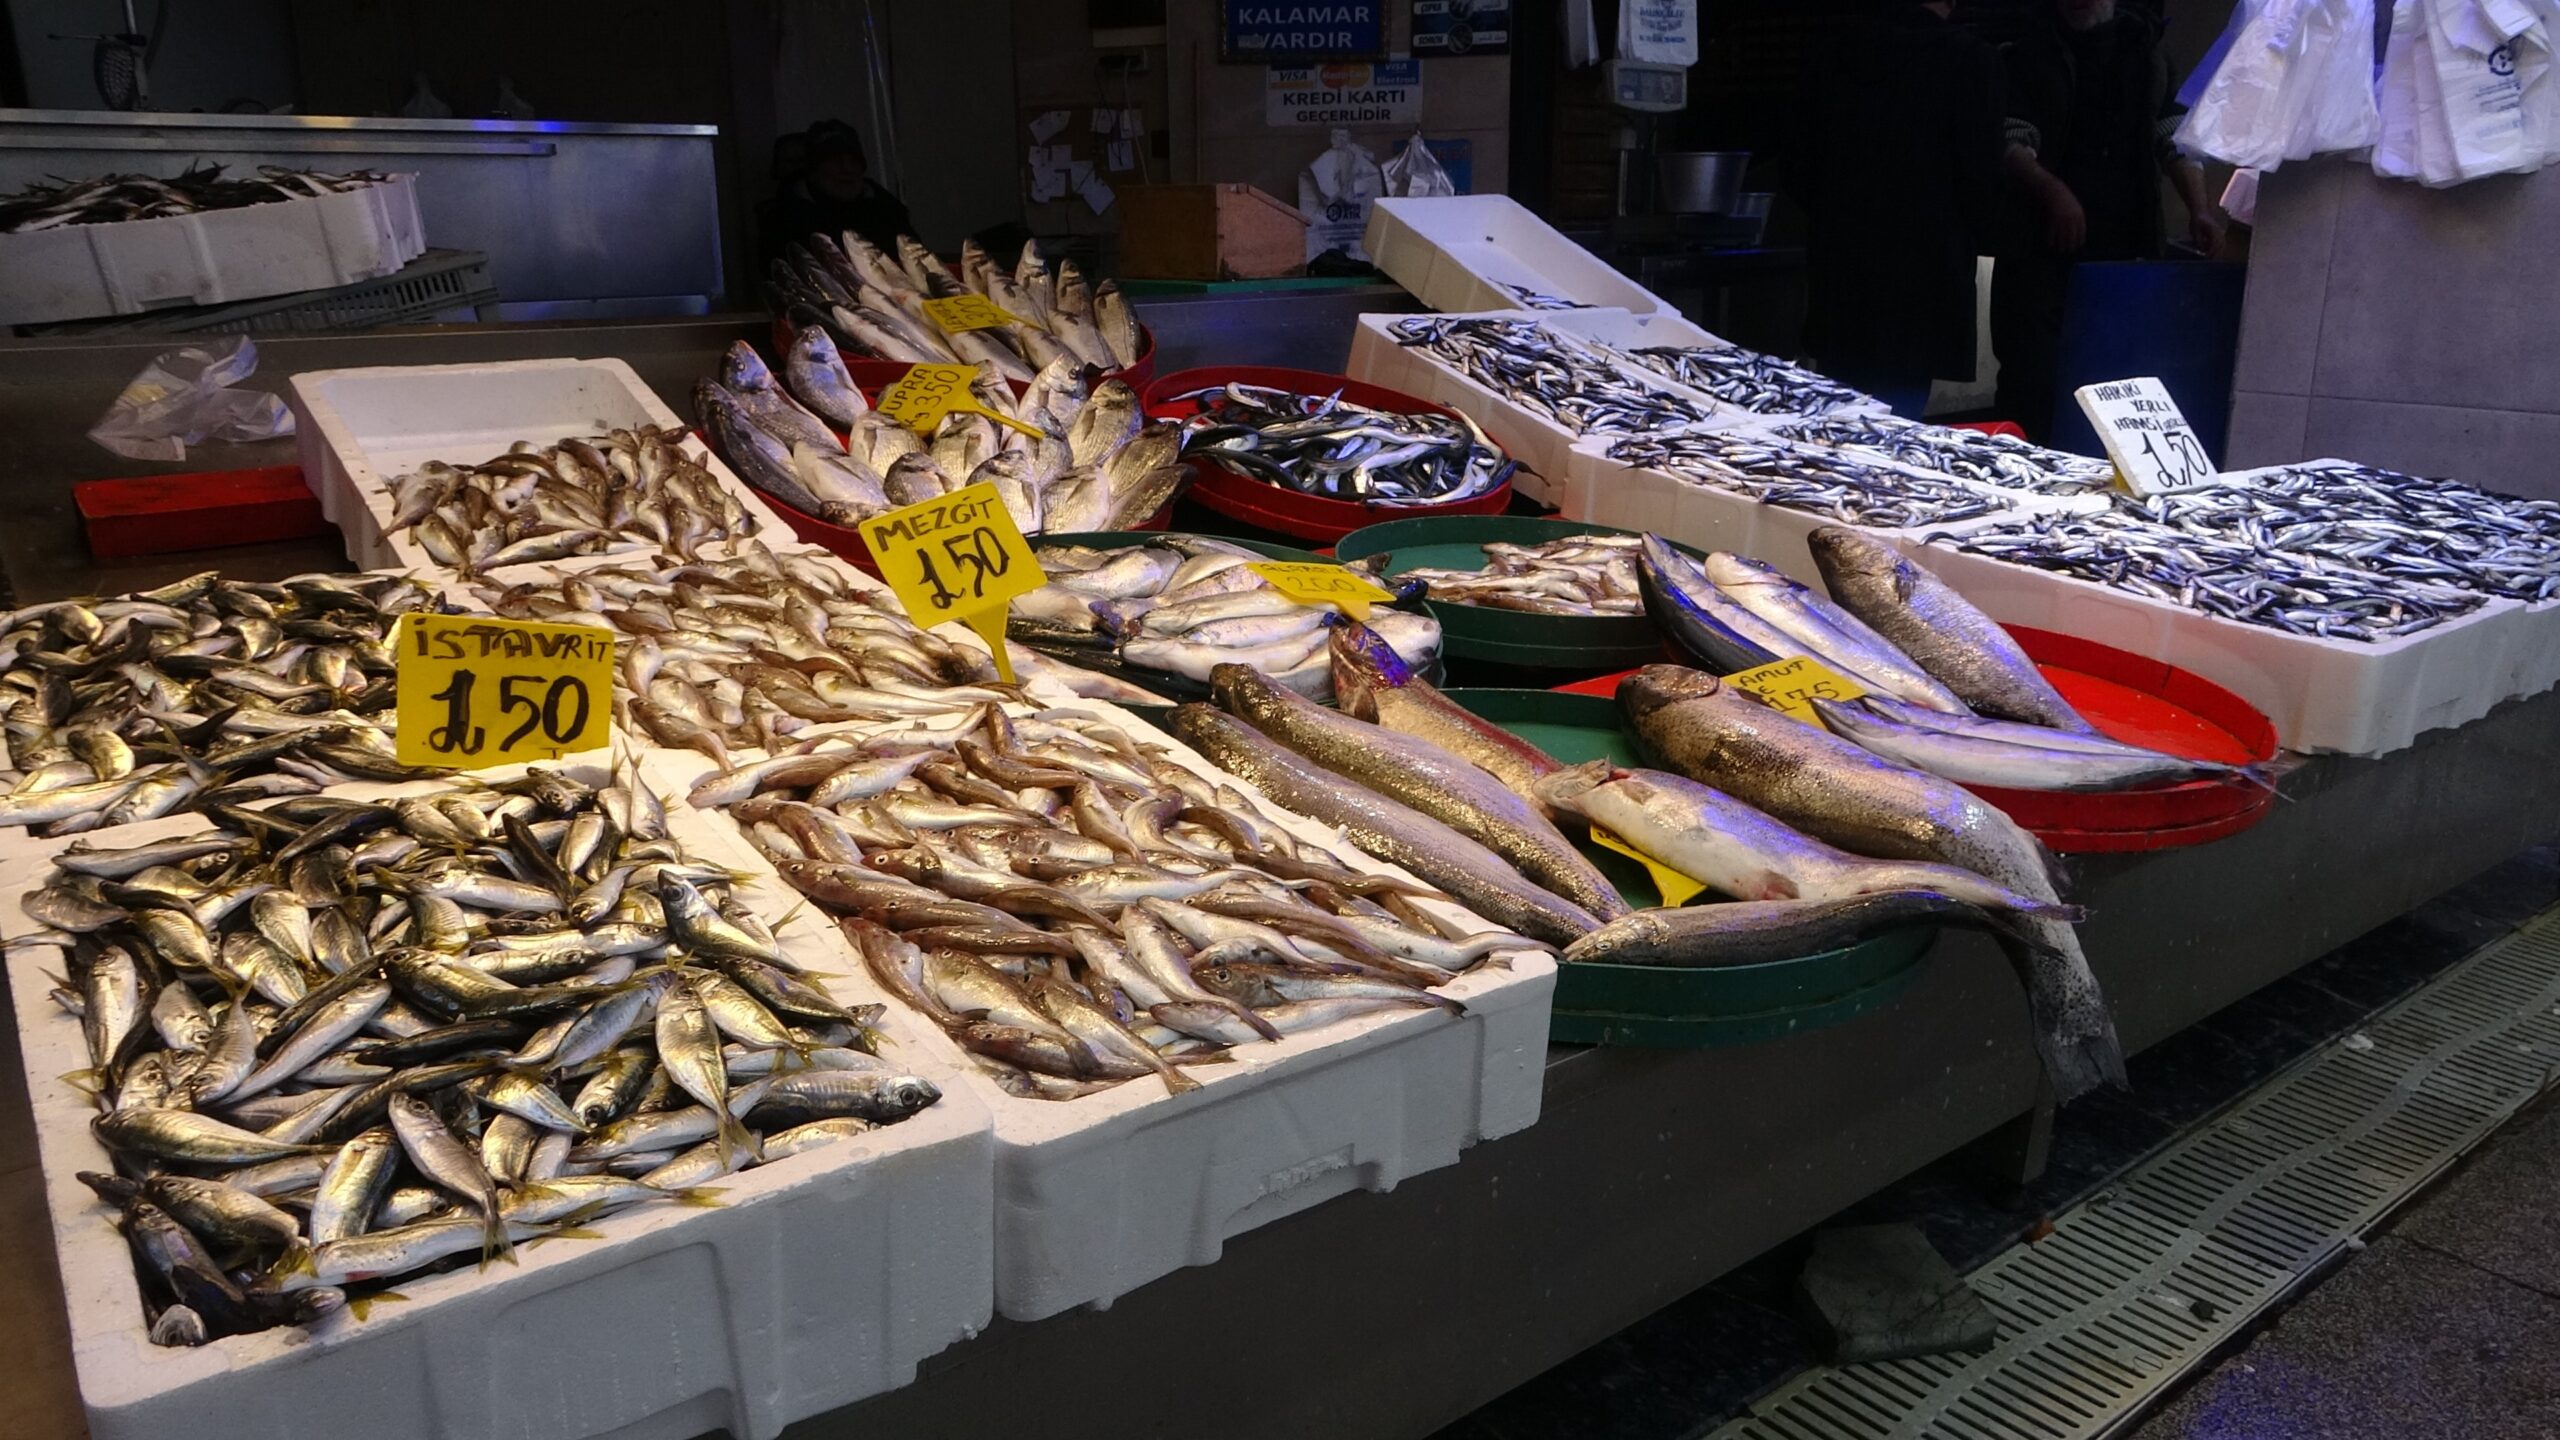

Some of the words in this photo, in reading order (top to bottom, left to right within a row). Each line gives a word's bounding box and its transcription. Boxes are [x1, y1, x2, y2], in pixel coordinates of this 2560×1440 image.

[1239, 6, 1370, 24] KALAMAR
[1385, 63, 1408, 71] VISA
[1279, 71, 1308, 81] VISA
[1377, 76, 1417, 84] Electron
[1283, 89, 1341, 106] KREDİ
[1348, 90, 1405, 104] KARTI
[1296, 108, 1391, 124] GEÇERLİDİR
[914, 369, 960, 409] 350
[872, 496, 994, 552] MEZGİT
